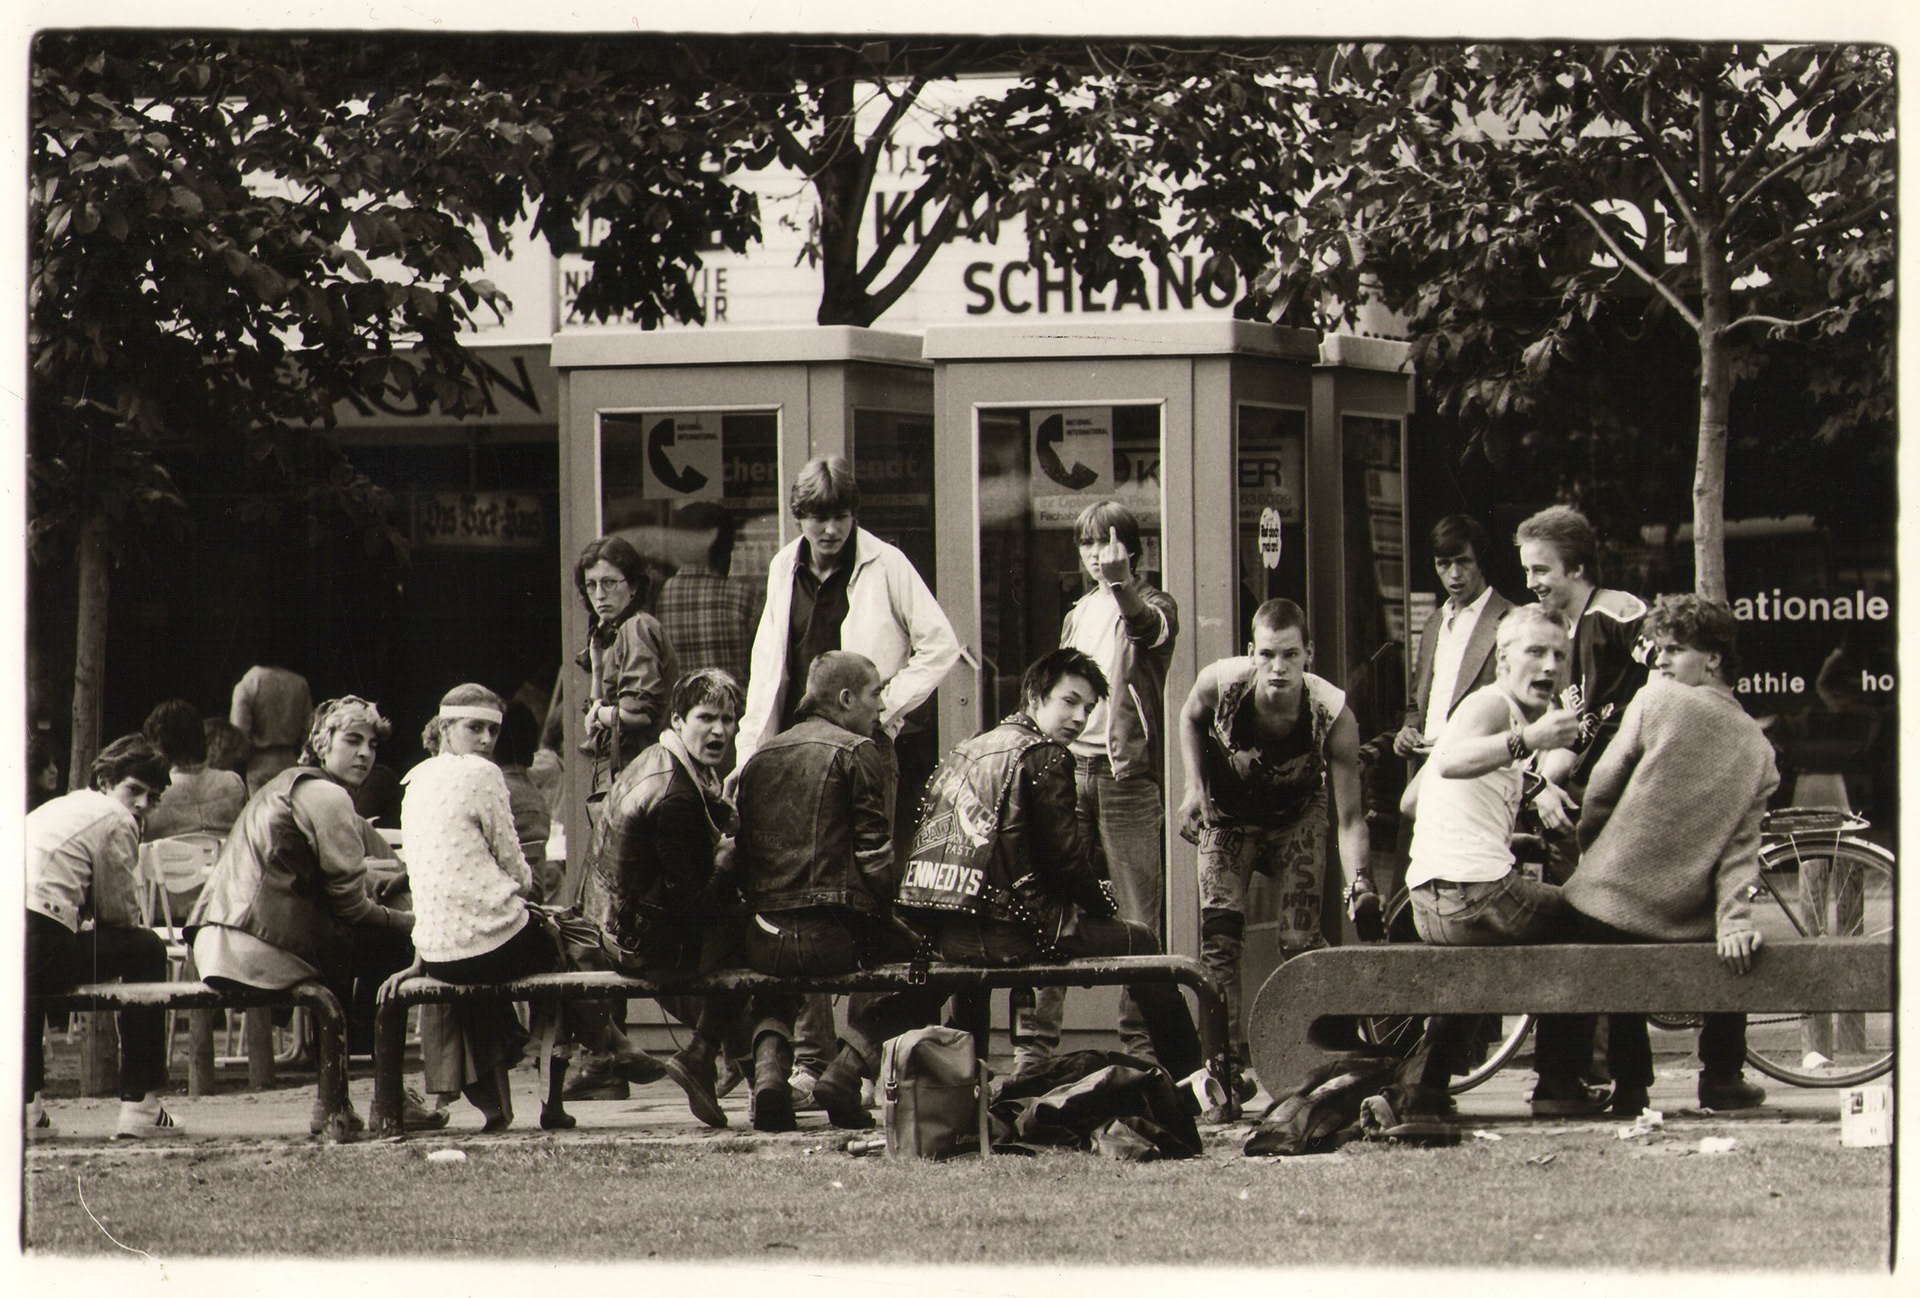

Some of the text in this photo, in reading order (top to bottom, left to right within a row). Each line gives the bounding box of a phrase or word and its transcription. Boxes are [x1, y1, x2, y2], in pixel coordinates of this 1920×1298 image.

[1065, 418, 1093, 426] NATIONAL
[1065, 427, 1109, 436] INTERNATIONAL
[723, 456, 778, 481] cher
[1239, 457, 1282, 488] ER
[1733, 588, 1890, 621] ationale
[1737, 670, 1895, 694] athie ho
[904, 860, 984, 896] ENNEDYS
